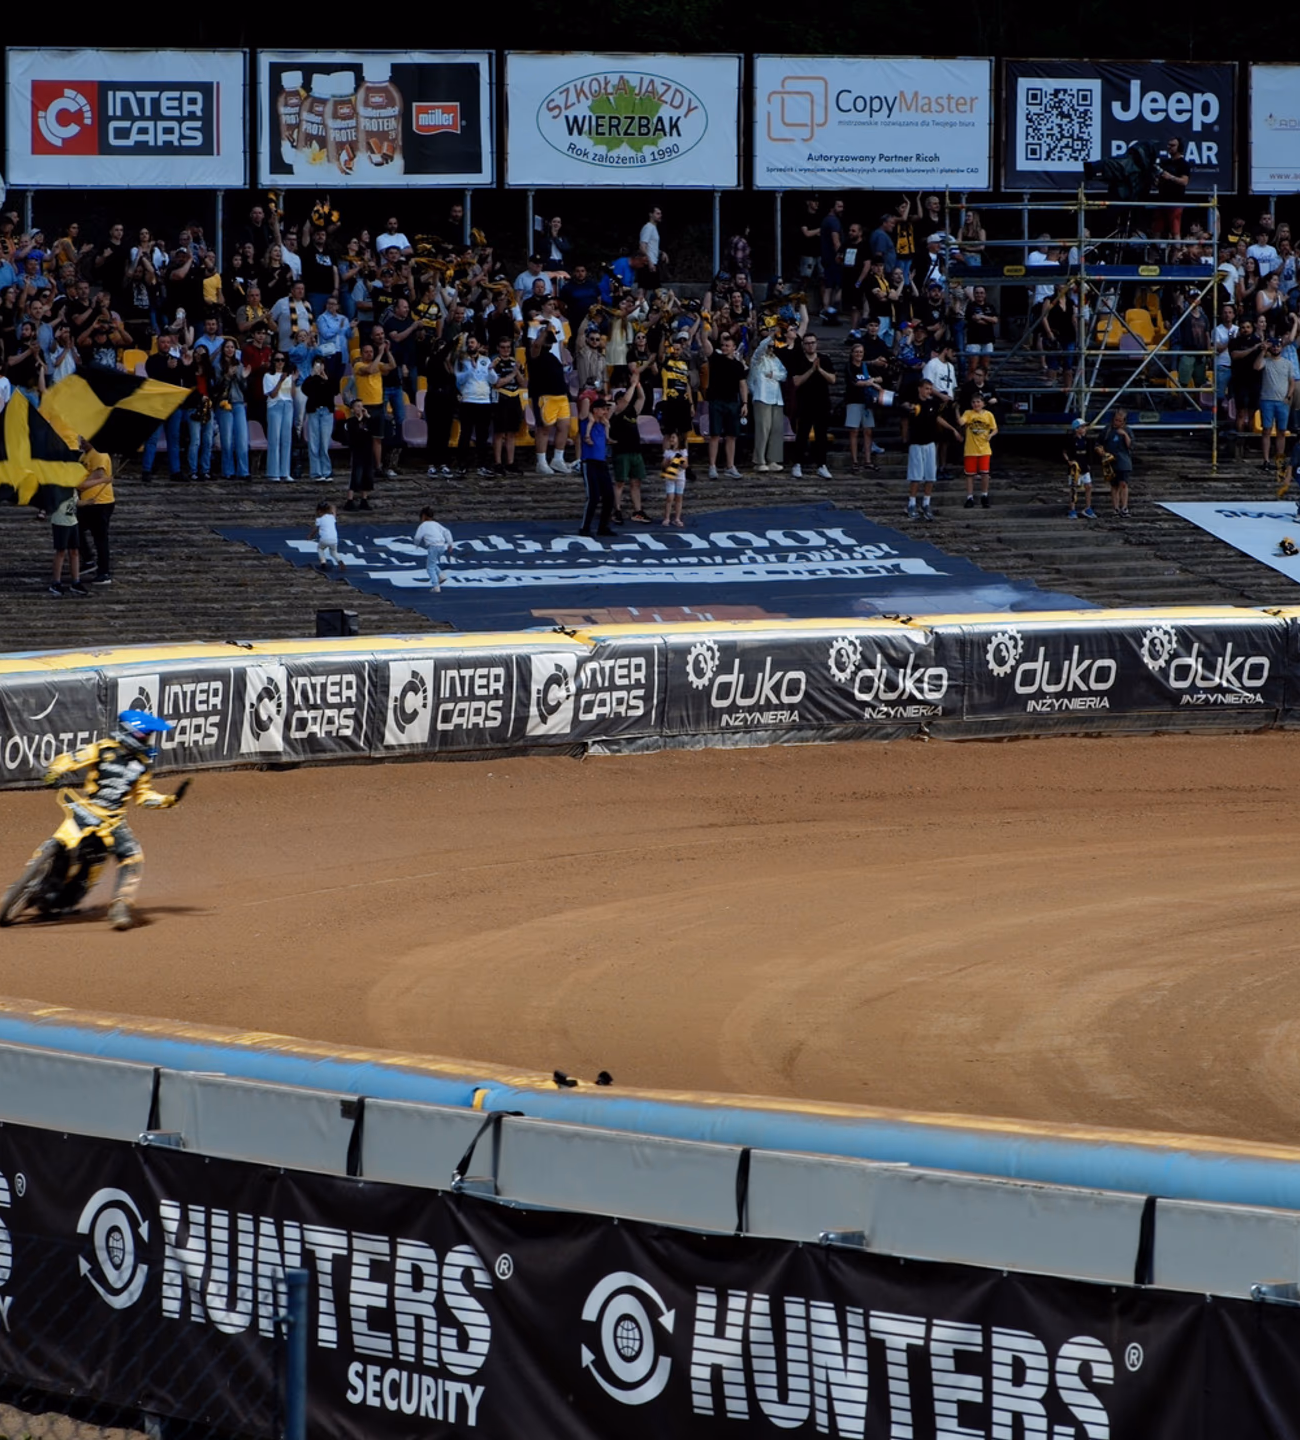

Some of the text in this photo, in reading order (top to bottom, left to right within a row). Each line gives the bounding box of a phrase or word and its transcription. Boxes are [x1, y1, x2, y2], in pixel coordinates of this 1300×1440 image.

[107, 90, 204, 117] INTER
[546, 75, 699, 120] SZKOŁA JAZDY
[835, 89, 979, 119] CopyMaster
[1111, 79, 1220, 132] Jeep
[107, 120, 204, 147] CARS
[418, 108, 455, 127] müller
[564, 114, 683, 138] WIERZBAK
[566, 141, 681, 165] Rok założenia 1990
[806, 152, 940, 164] Autoryzowany Partner Ricoh
[439, 666, 505, 698] INTER
[580, 656, 648, 688] INTER
[710, 656, 807, 709] duko
[1014, 645, 1117, 695] duko
[163, 680, 223, 715] INTER
[291, 674, 357, 706] INTER
[578, 688, 646, 722] CARS
[1025, 692, 1111, 713] INŻYNIERIA
[160, 710, 221, 750] CARS
[289, 706, 355, 739] CARS
[436, 699, 503, 731] CARS
[720, 706, 801, 728] INŻYNIERIA
[160, 1198, 495, 1376] HUNTERS
[689, 1285, 1116, 1440] HUNTERS
[345, 1360, 485, 1427] SECURITY
